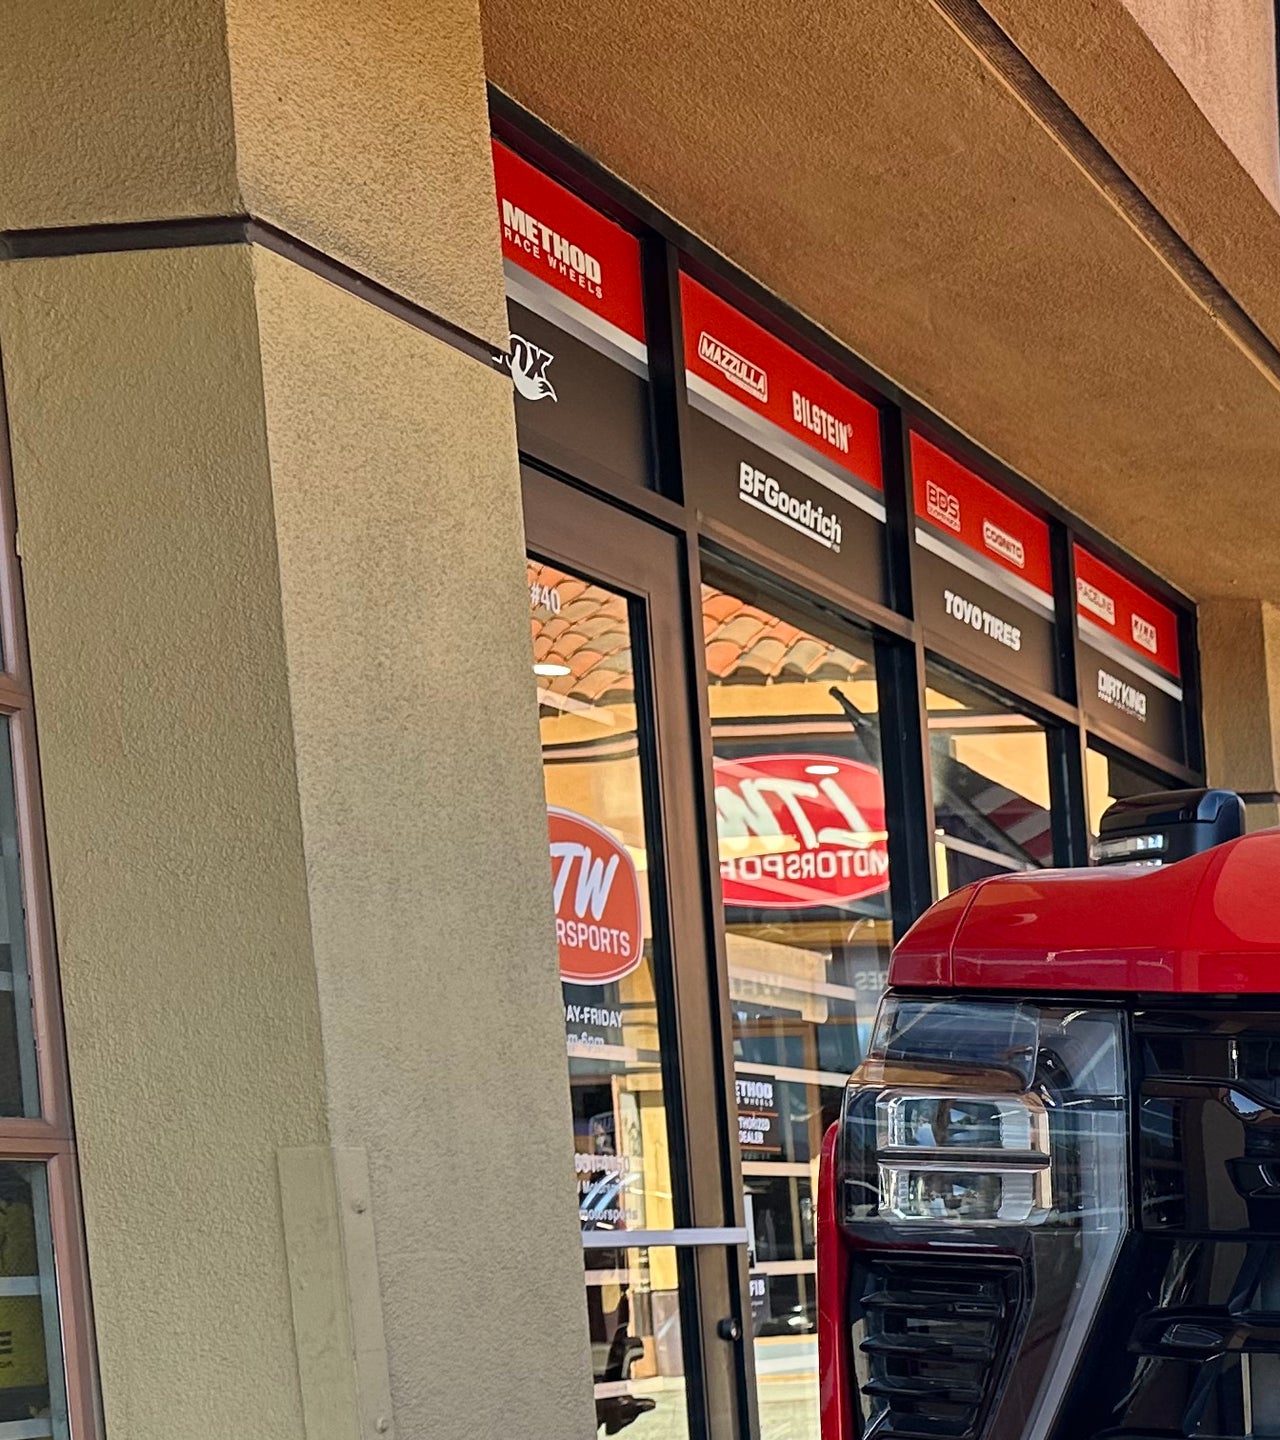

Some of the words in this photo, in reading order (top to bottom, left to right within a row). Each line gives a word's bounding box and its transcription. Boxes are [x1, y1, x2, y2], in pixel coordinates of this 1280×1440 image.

[502, 198, 602, 284] METHOD
[504, 226, 541, 259] RACE
[547, 253, 603, 299] WHEELS
[508, 334, 555, 390] OX
[701, 336, 765, 395] MAZZULLA
[792, 390, 849, 454] BILSTEIN
[739, 461, 842, 544] BFGoodrich
[928, 482, 960, 518] BDS
[530, 581, 561, 615] #40
[550, 841, 620, 922] TW
[555, 917, 631, 957] RSPORTS
[566, 1003, 623, 1029] AY-FRIDAY
[736, 1079, 773, 1100] ETHOD
[738, 1116, 770, 1132] THORIZED
